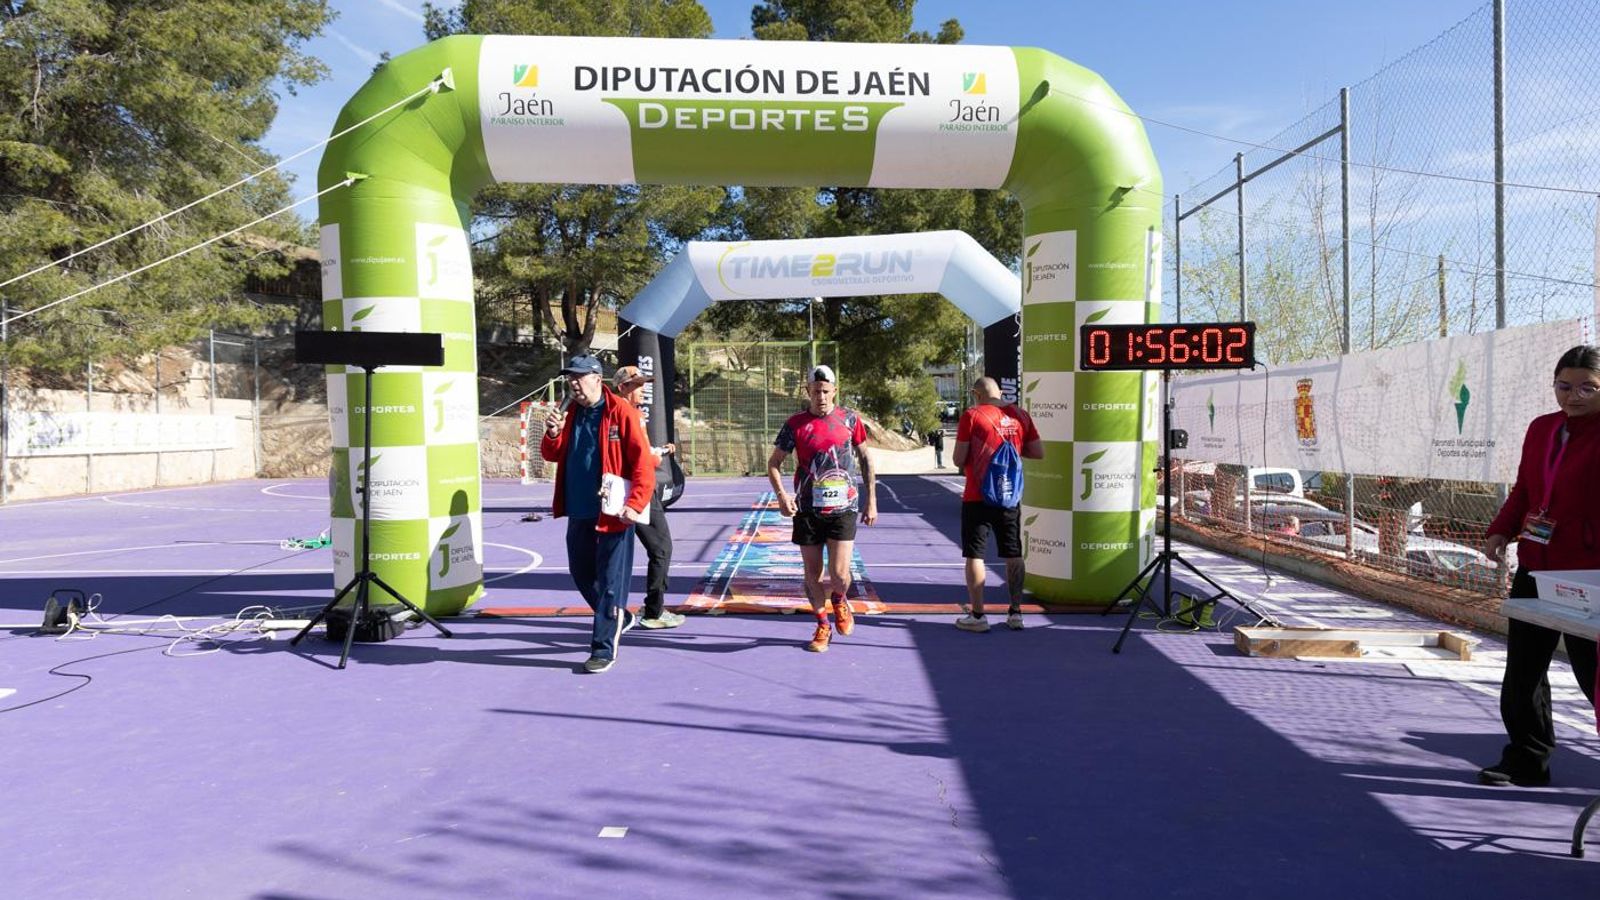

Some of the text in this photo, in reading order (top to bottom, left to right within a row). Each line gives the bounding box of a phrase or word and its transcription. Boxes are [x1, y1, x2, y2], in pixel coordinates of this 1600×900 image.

[574, 65, 930, 96] DIPUTACIÓN DE JAÉN
[499, 92, 553, 116] Jaén
[949, 99, 1000, 122] Jaén
[526, 117, 565, 126] INTERIOR
[972, 123, 1008, 133] INTERIOR
[730, 250, 913, 279] TIME2RUN
[872, 274, 915, 284] DEPORTIVO
[1025, 333, 1068, 342] DEPORTES
[1089, 328, 1247, 364] 01:56:02
[638, 355, 653, 405] LIMTES
[1083, 403, 1137, 411] DEPORTES
[1094, 472, 1137, 481] DIPUTACIÓN
[822, 490, 839, 498] 422
[1080, 542, 1134, 550] DEPORTES
